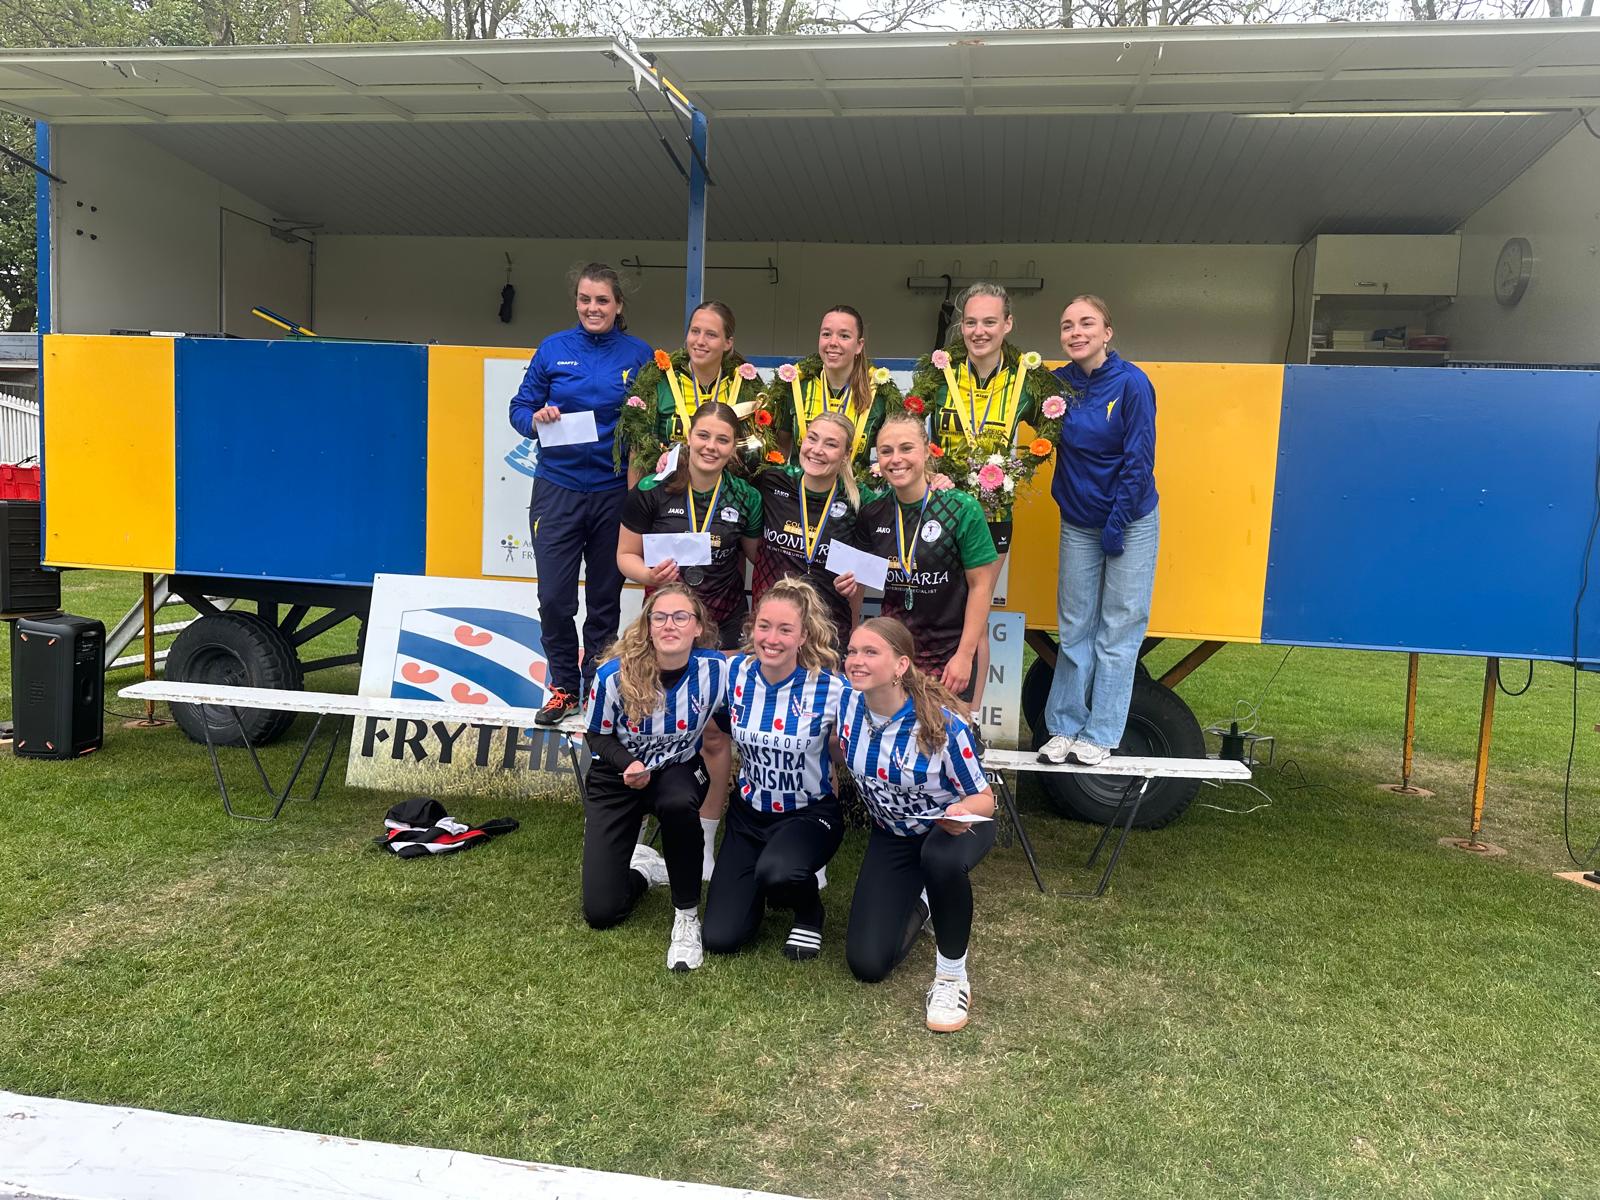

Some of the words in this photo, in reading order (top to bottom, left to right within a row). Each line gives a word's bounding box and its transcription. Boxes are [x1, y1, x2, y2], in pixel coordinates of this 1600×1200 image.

[774, 489, 790, 498] JAKO
[667, 507, 685, 515] JAKO
[875, 526, 891, 534] JAKO
[732, 728, 812, 750] OUWGROEP
